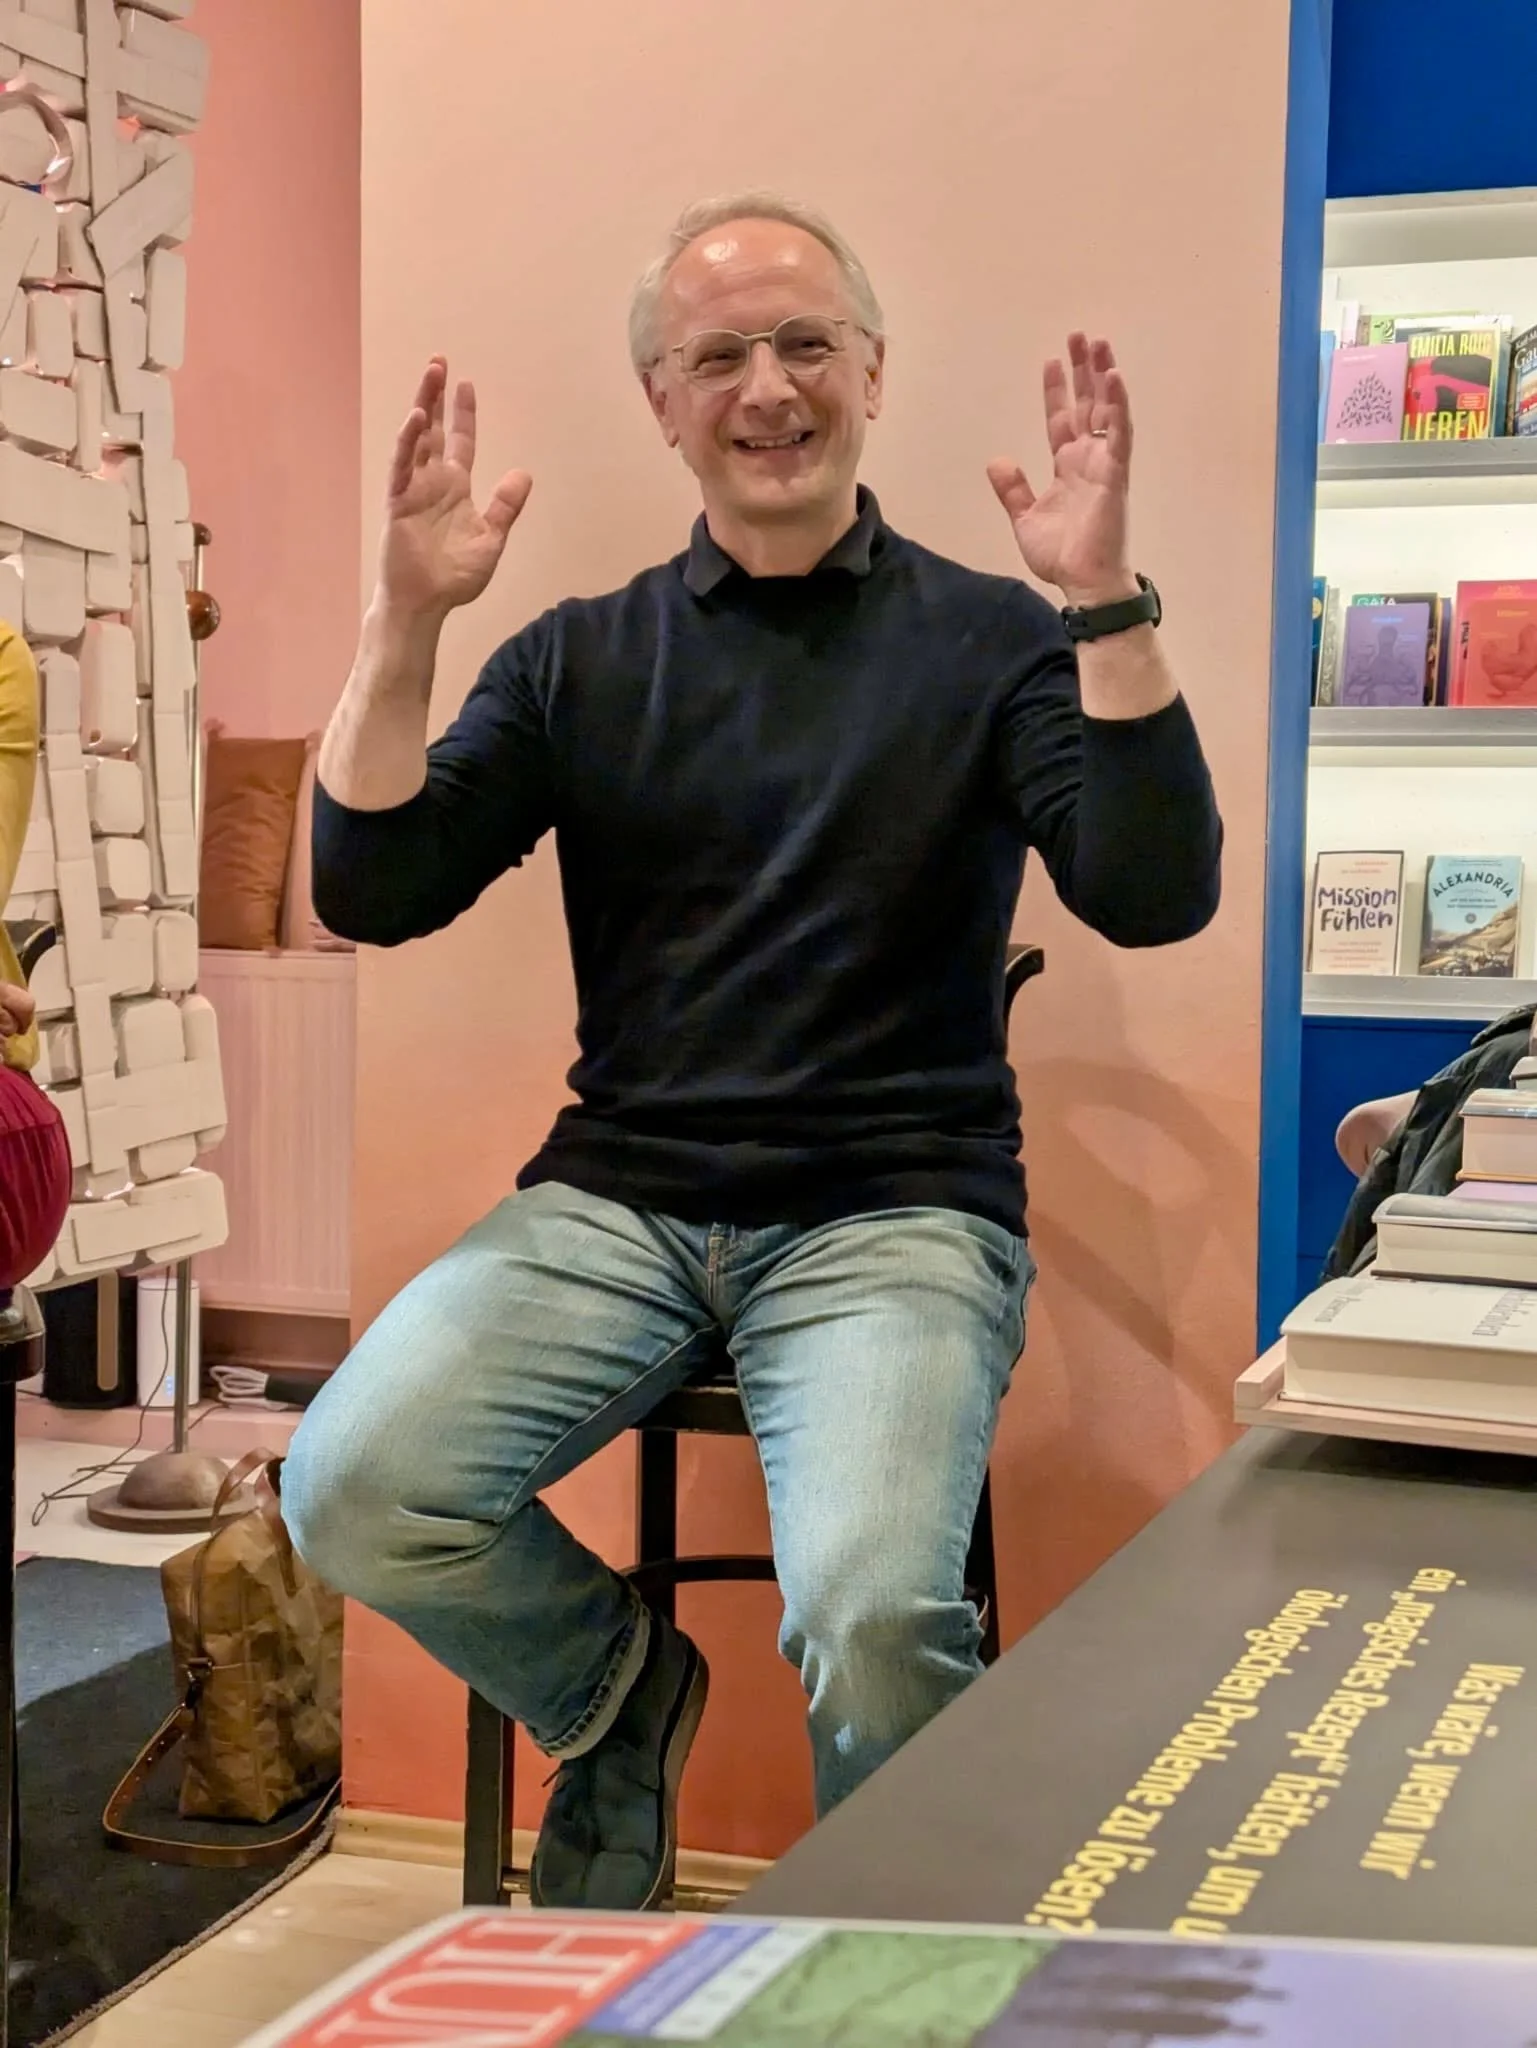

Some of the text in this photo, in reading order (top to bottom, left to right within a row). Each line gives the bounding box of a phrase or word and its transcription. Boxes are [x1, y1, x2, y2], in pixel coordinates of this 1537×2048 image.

[1410, 333, 1455, 358] EMILIA
[1403, 411, 1485, 441] LIEBEN
[1317, 887, 1397, 909] Mission
[1432, 871, 1514, 898] ALEXANDRIA
[1321, 908, 1393, 932] Fühlen
[1409, 1567, 1467, 1593] ein
[1212, 1588, 1349, 1701] ökologischen
[1126, 1699, 1259, 1807] Probleme
[1360, 1662, 1525, 1880] Was wäre, wenn wir
[1098, 1804, 1163, 1841] zu
[1207, 1772, 1341, 1861] hätten,
[1186, 1864, 1263, 1916] um
